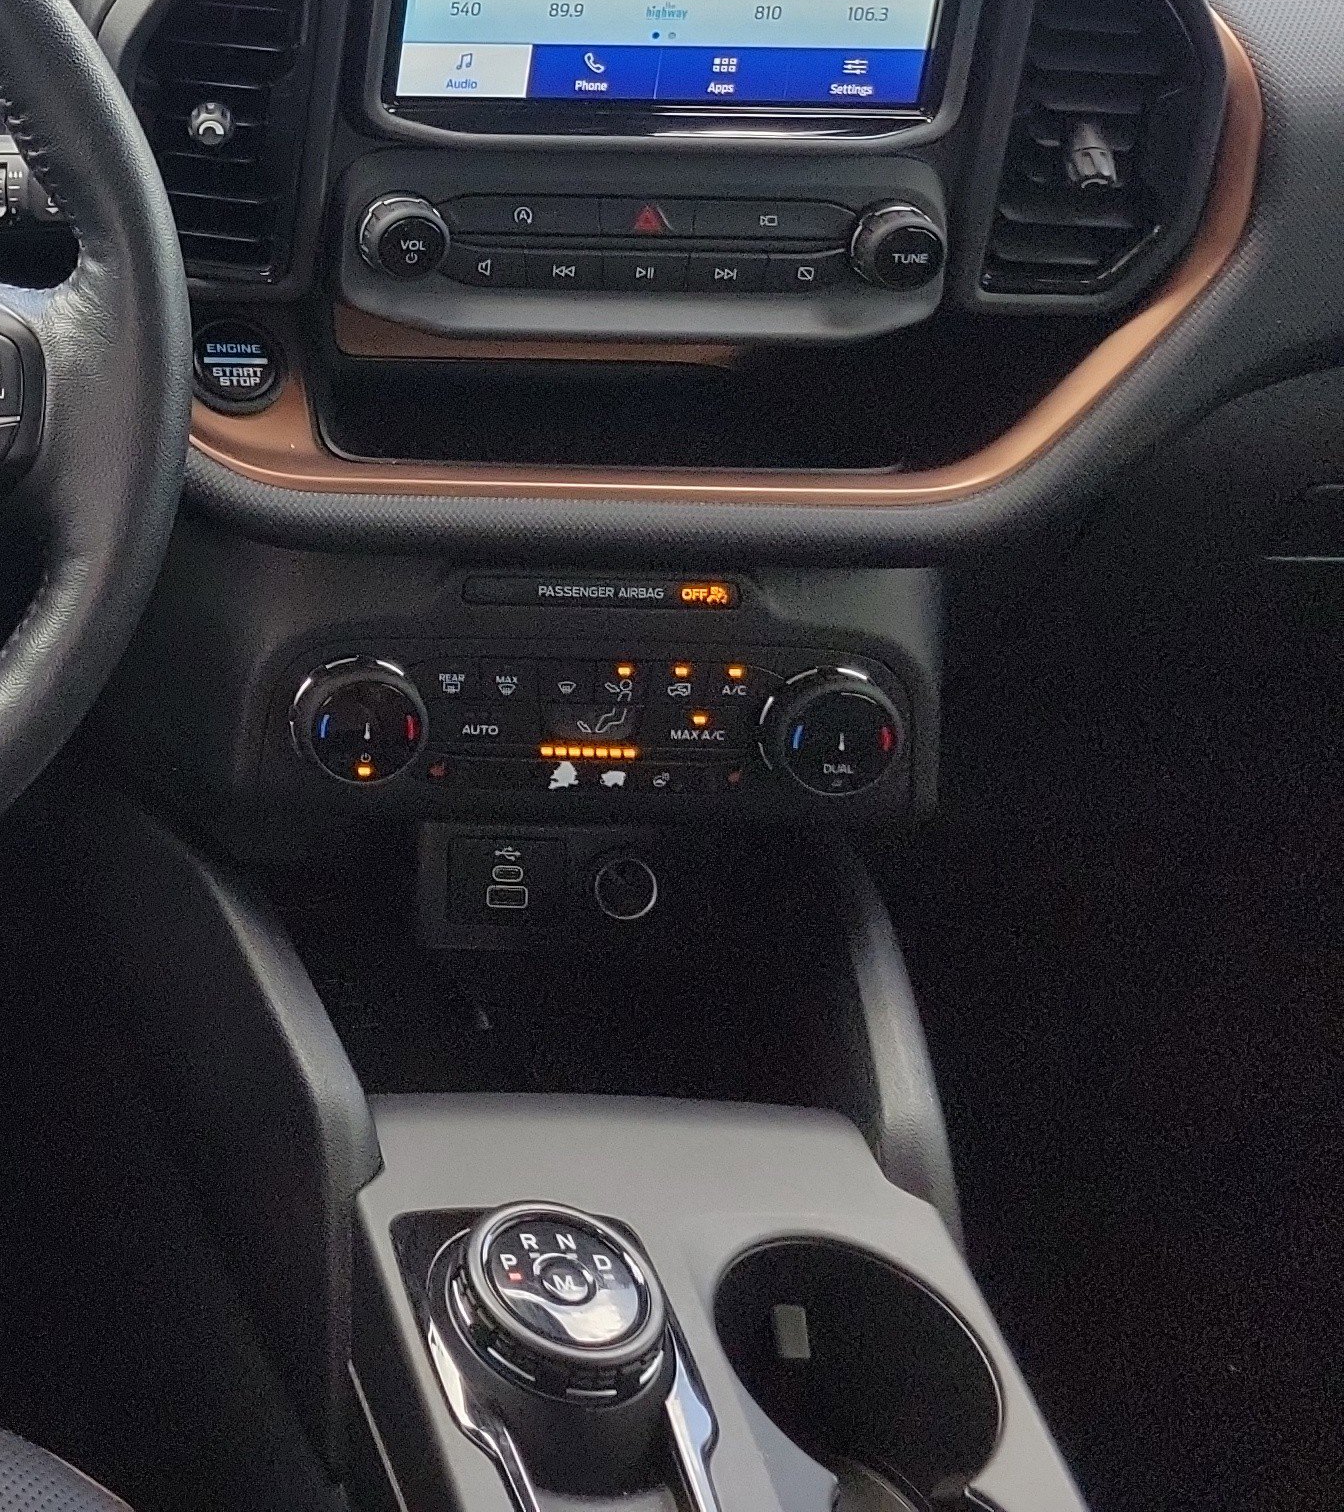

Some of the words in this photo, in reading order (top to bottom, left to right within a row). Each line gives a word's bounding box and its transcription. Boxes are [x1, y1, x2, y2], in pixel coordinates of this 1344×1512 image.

[450, 1, 482, 16] 540
[548, 3, 585, 18] 89.9
[645, 5, 688, 20] highway
[754, 5, 782, 20] 810
[847, 7, 889, 22] 106.3
[445, 79, 478, 90] Audio
[575, 80, 608, 91] Phone
[707, 82, 735, 94] Apps
[829, 83, 873, 96] Settings
[400, 239, 426, 251] VOL
[892, 253, 929, 264] TUNE
[206, 342, 261, 354] ENGINE
[212, 366, 263, 377] START
[220, 376, 261, 387] STOP
[538, 585, 614, 598] PASSENGER
[618, 586, 664, 599] AIRBAG
[681, 587, 708, 600] OFF
[438, 673, 465, 682] REAR
[495, 675, 518, 684] MAX
[721, 684, 747, 696] A/C
[462, 724, 499, 735] AUTO
[670, 729, 699, 740] MAX
[702, 730, 725, 741] A/C
[823, 763, 854, 774] DUAL
[519, 1233, 539, 1249] R
[555, 1233, 577, 1250] N
[499, 1253, 517, 1270] P
[592, 1254, 612, 1271] D
[552, 1274, 575, 1291] M
